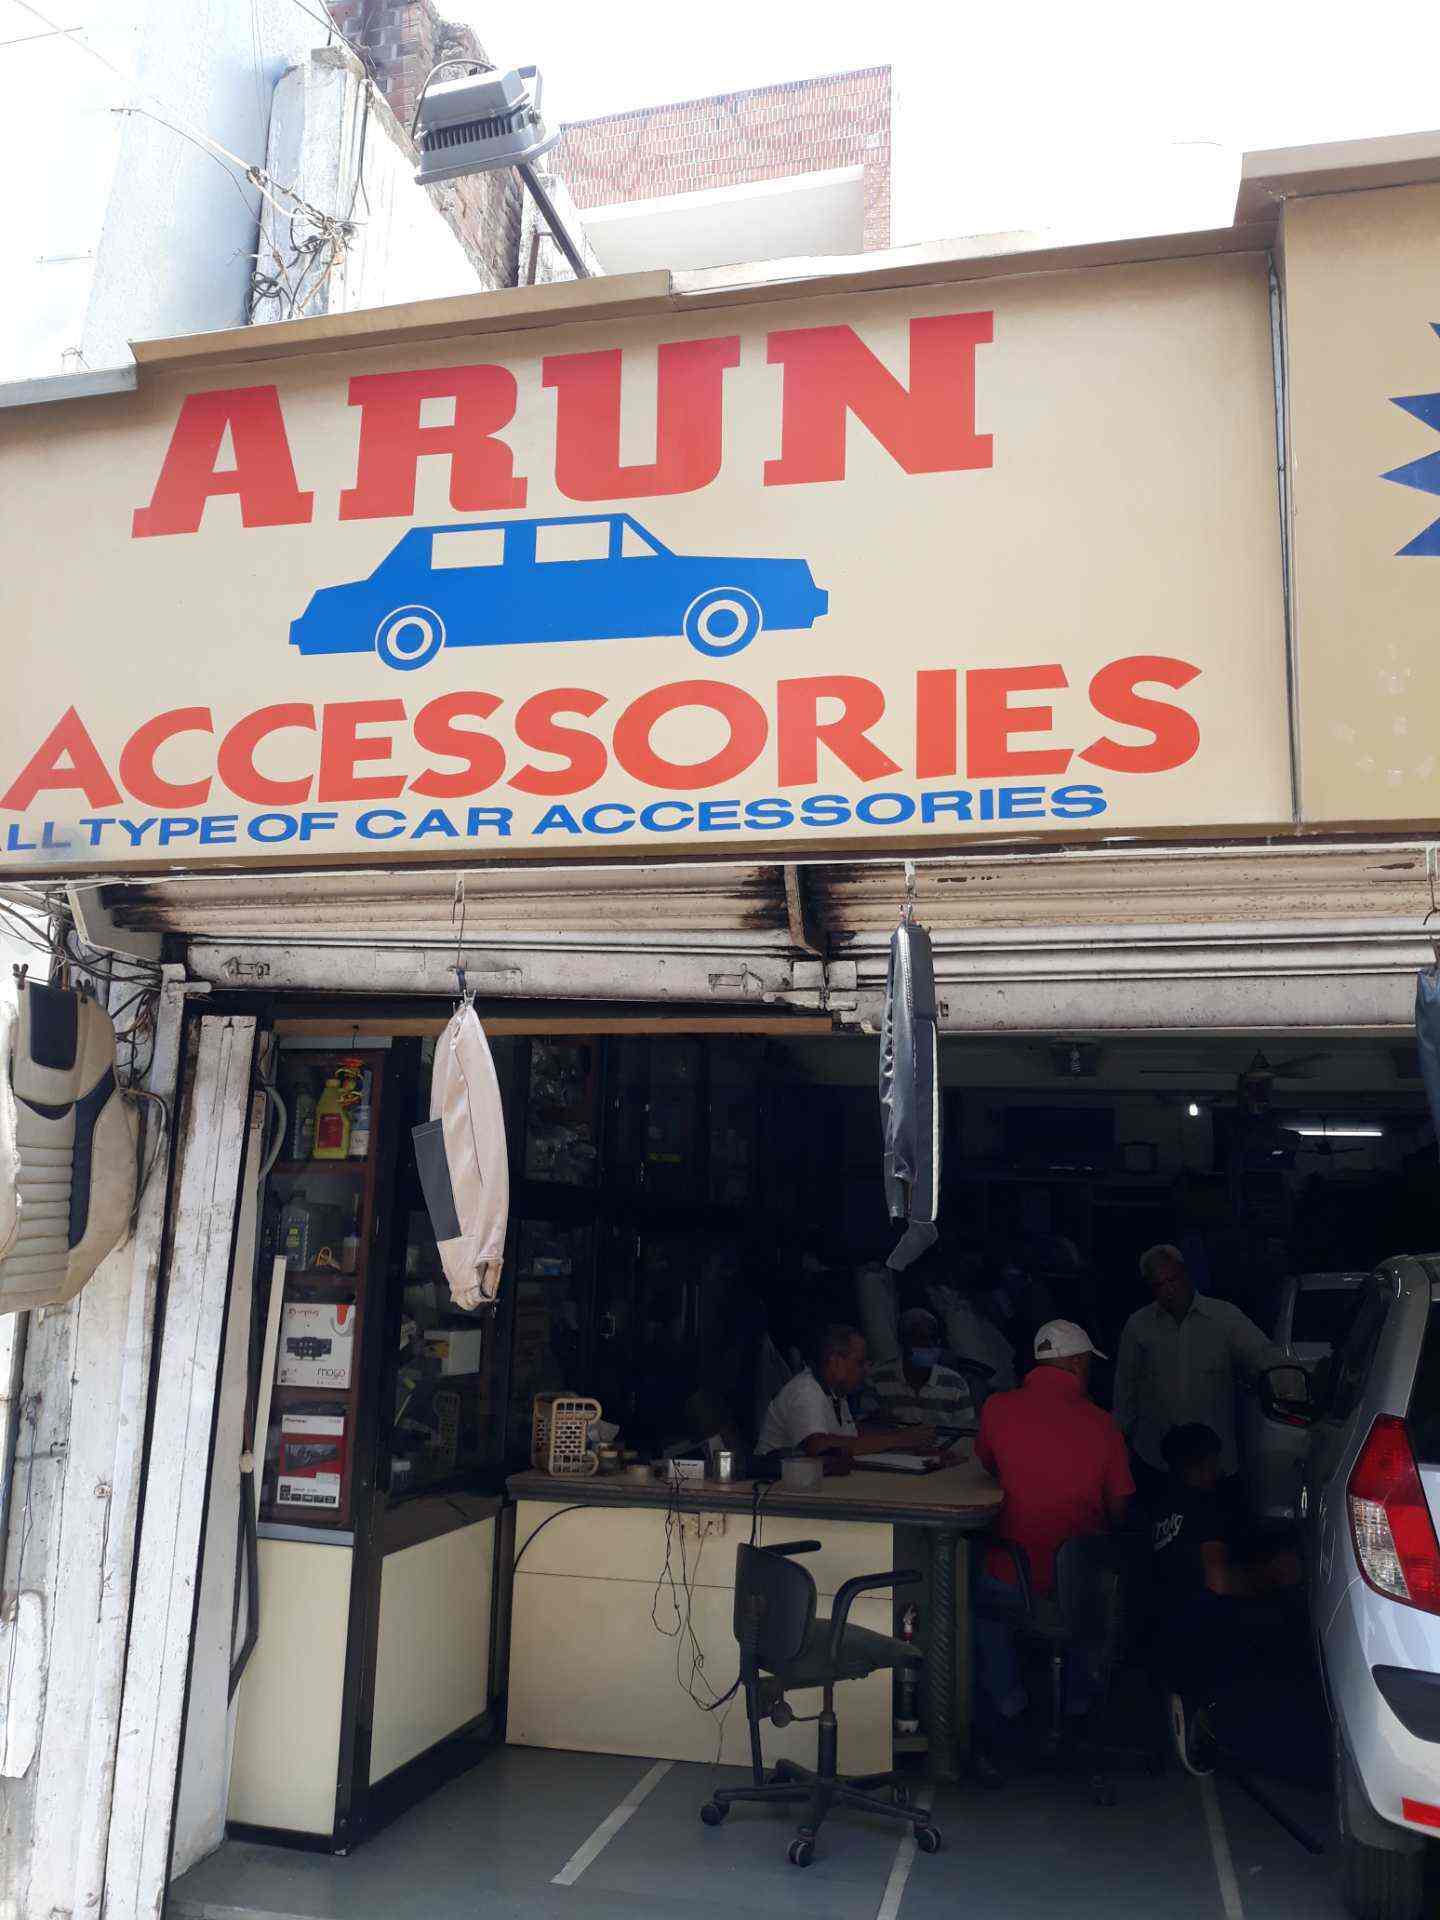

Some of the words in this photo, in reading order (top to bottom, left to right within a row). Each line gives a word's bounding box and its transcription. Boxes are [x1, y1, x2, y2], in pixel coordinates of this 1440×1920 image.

[131, 310, 994, 538] ARUN
[0, 655, 1202, 812] ACCESSORIES
[0, 820, 72, 852] LL
[79, 816, 239, 847] TYPE
[246, 811, 339, 842] OF
[354, 807, 514, 841] CAR
[531, 784, 1108, 837] ACCESSORIES
